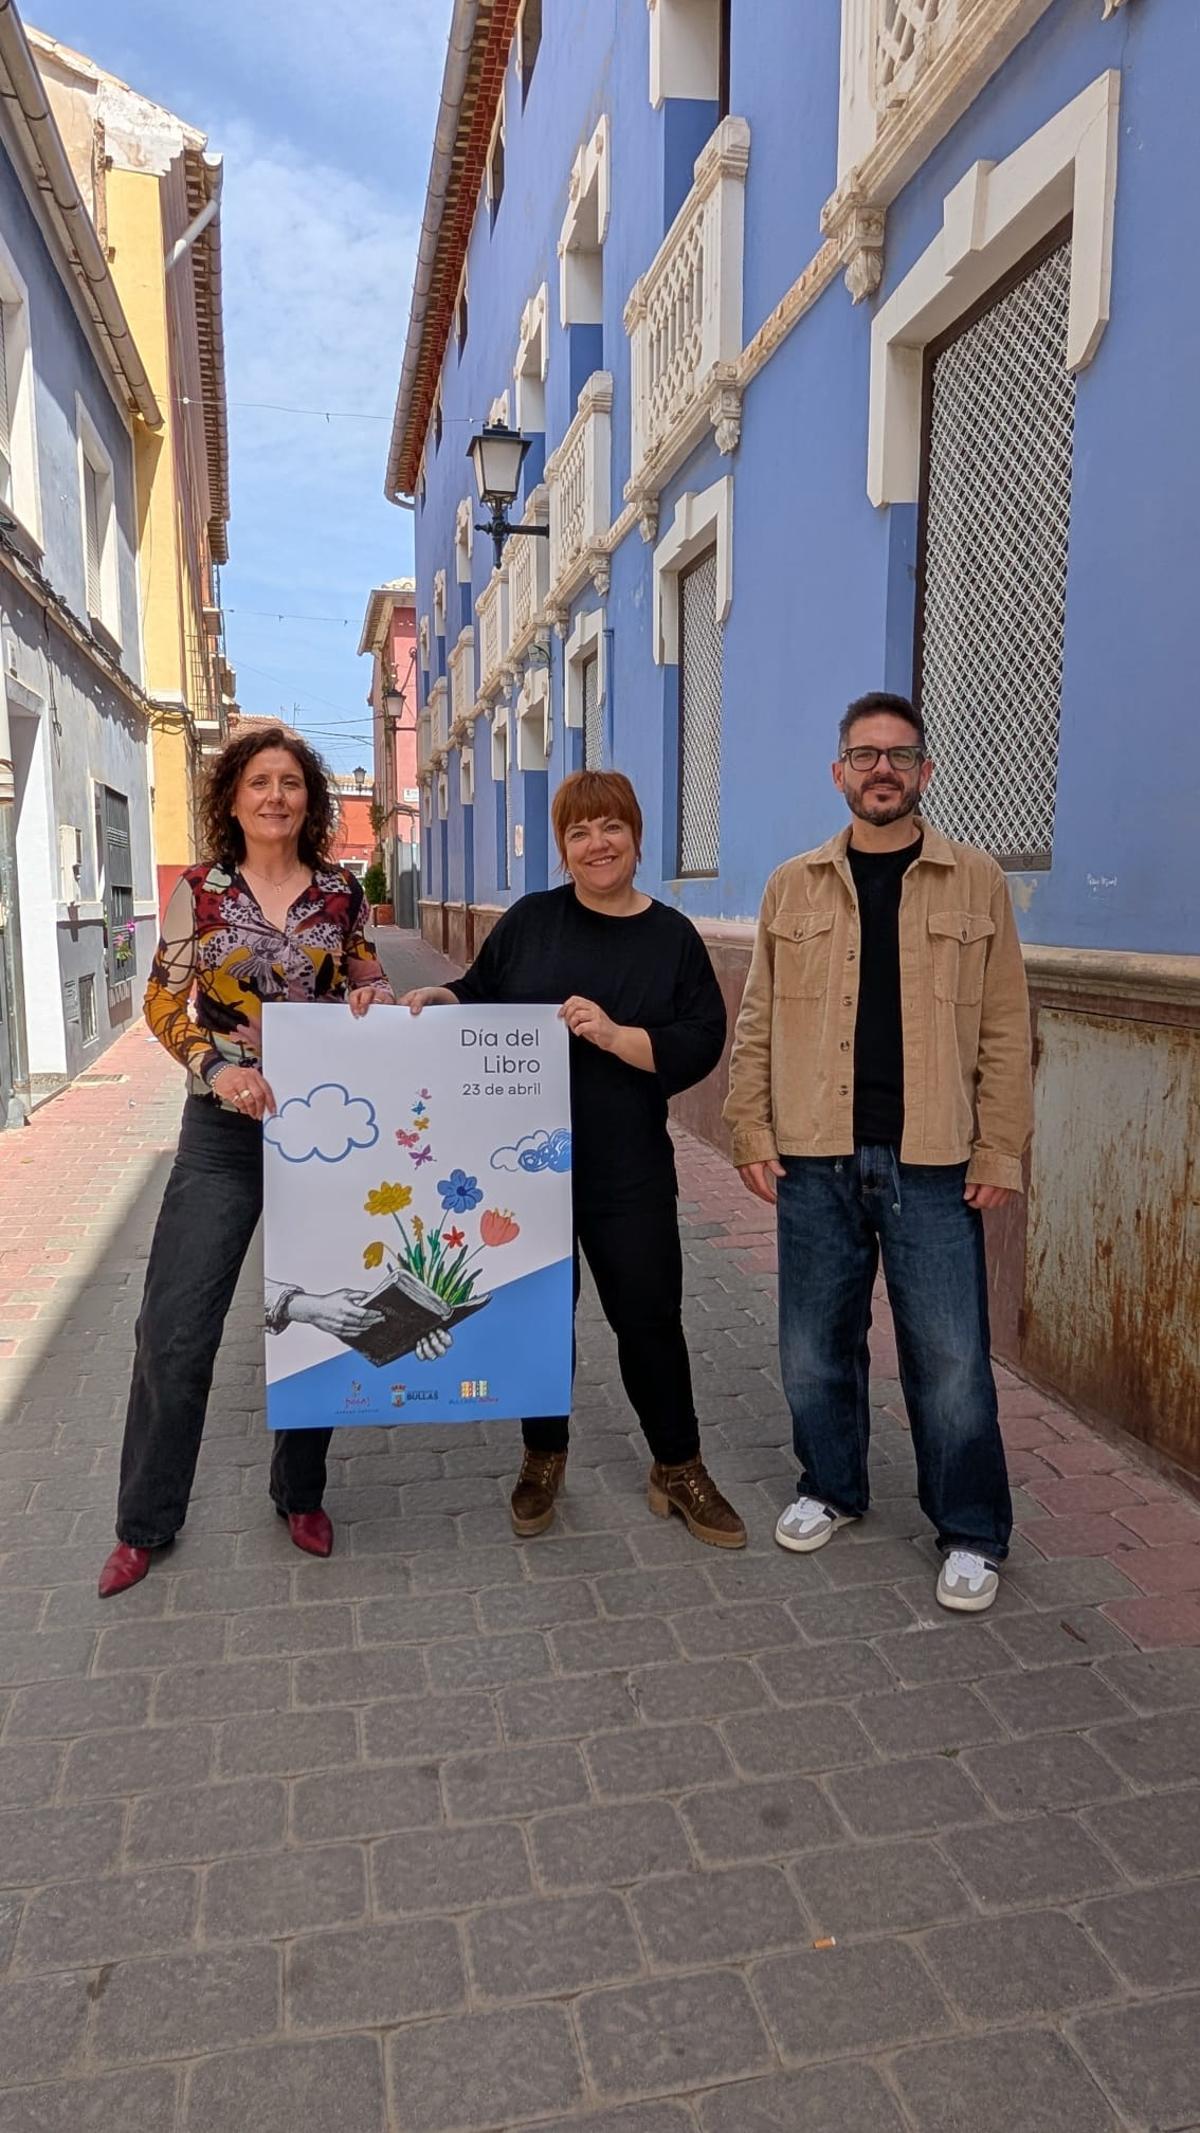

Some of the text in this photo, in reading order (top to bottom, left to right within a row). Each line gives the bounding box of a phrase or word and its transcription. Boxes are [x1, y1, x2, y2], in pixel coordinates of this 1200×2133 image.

[461, 1028, 539, 1046] Día del
[484, 1055, 540, 1073] Libro
[462, 1082, 541, 1095] 23 de abril
